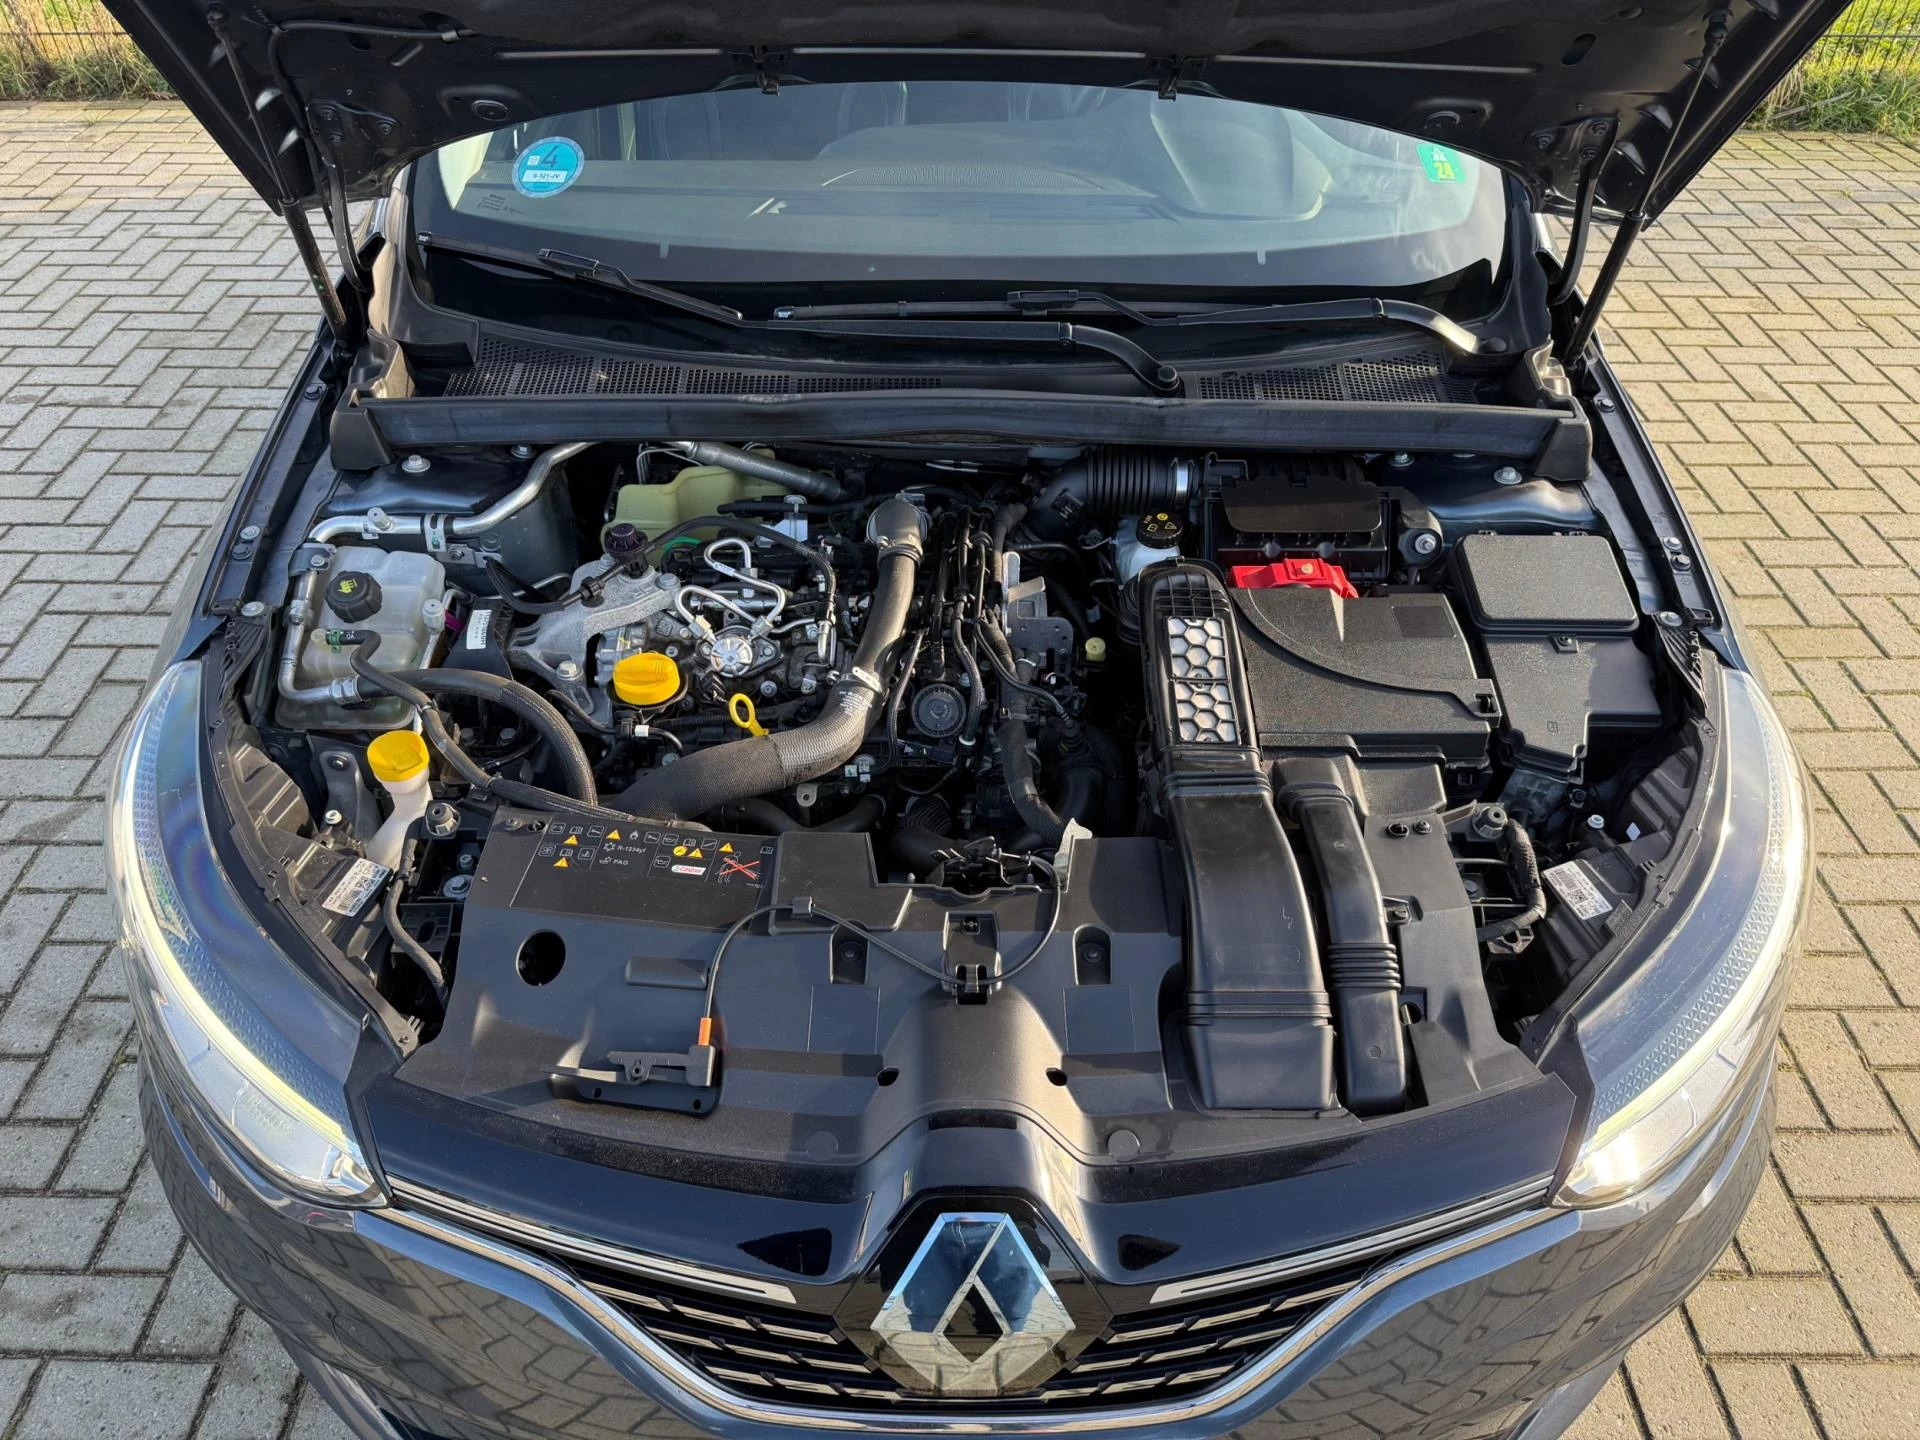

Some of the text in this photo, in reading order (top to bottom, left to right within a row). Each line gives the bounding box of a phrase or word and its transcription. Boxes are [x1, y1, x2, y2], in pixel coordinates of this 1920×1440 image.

[541, 145, 559, 167] 4
[617, 845, 646, 854] R-1234yf
[680, 865, 704, 874] Castrol
